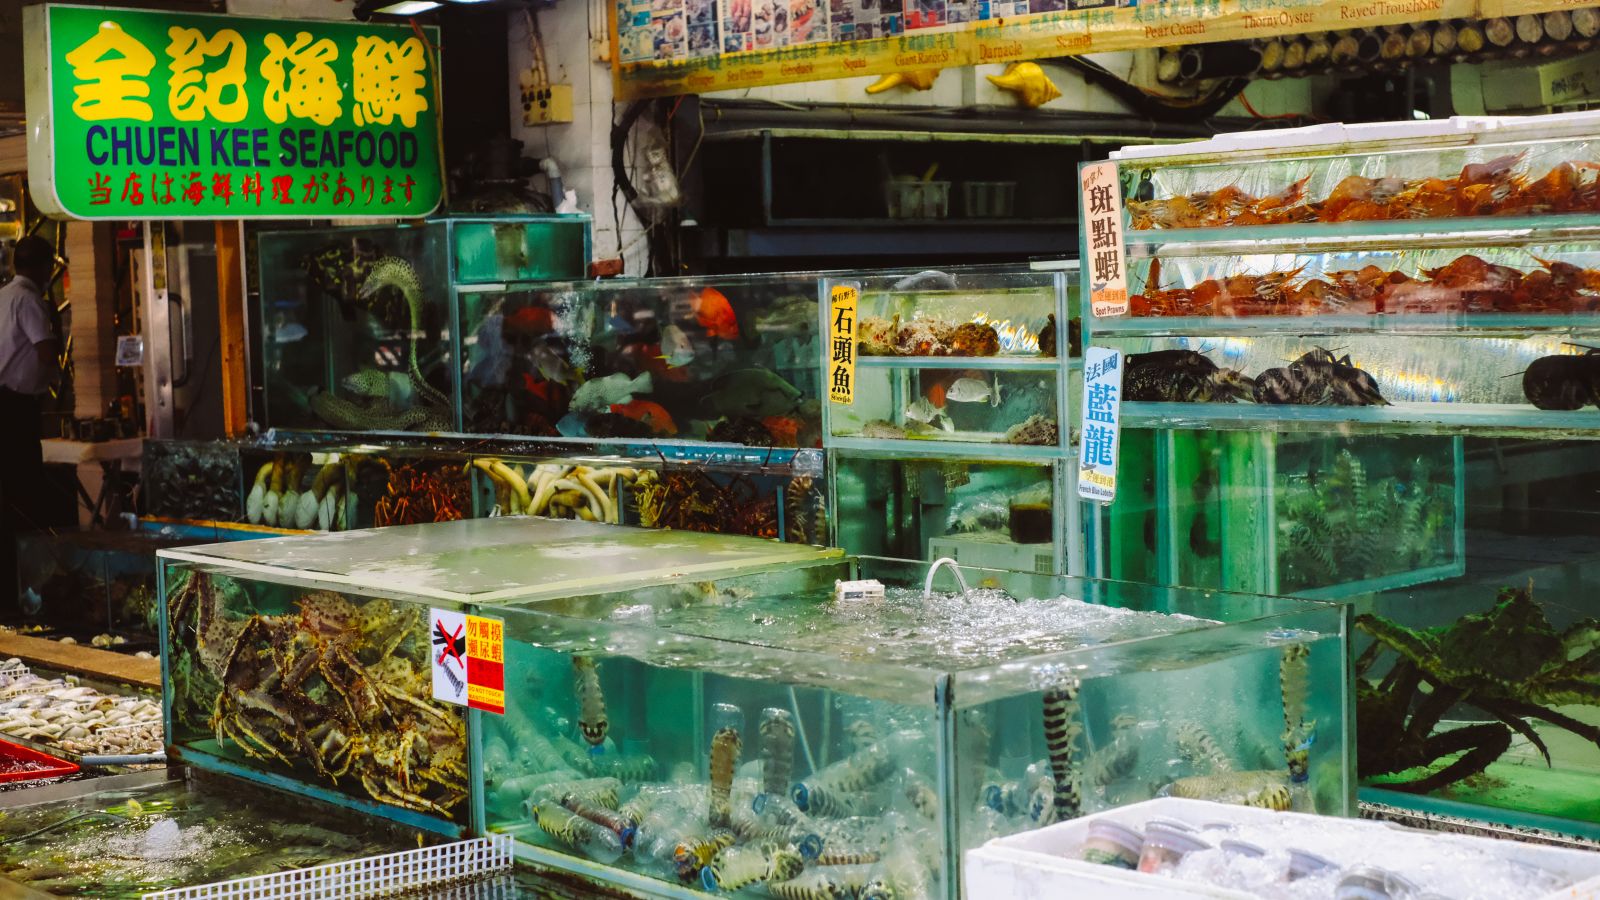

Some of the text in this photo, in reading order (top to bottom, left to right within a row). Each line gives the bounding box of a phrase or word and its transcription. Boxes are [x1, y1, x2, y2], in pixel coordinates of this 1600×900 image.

[1144, 20, 1205, 39] Pear Conch
[65, 20, 429, 128] 全記海鮮
[86, 124, 419, 169] CHUEN KEE SEAFOOD
[87, 171, 418, 209] 当店は海鮮料理があります
[1088, 183, 1120, 282] 斑點蝦
[1107, 305, 1125, 315] Prawns
[832, 306, 854, 395] 石頭魚
[1086, 353, 1118, 382] 法國
[1085, 383, 1117, 466] 藍龍
